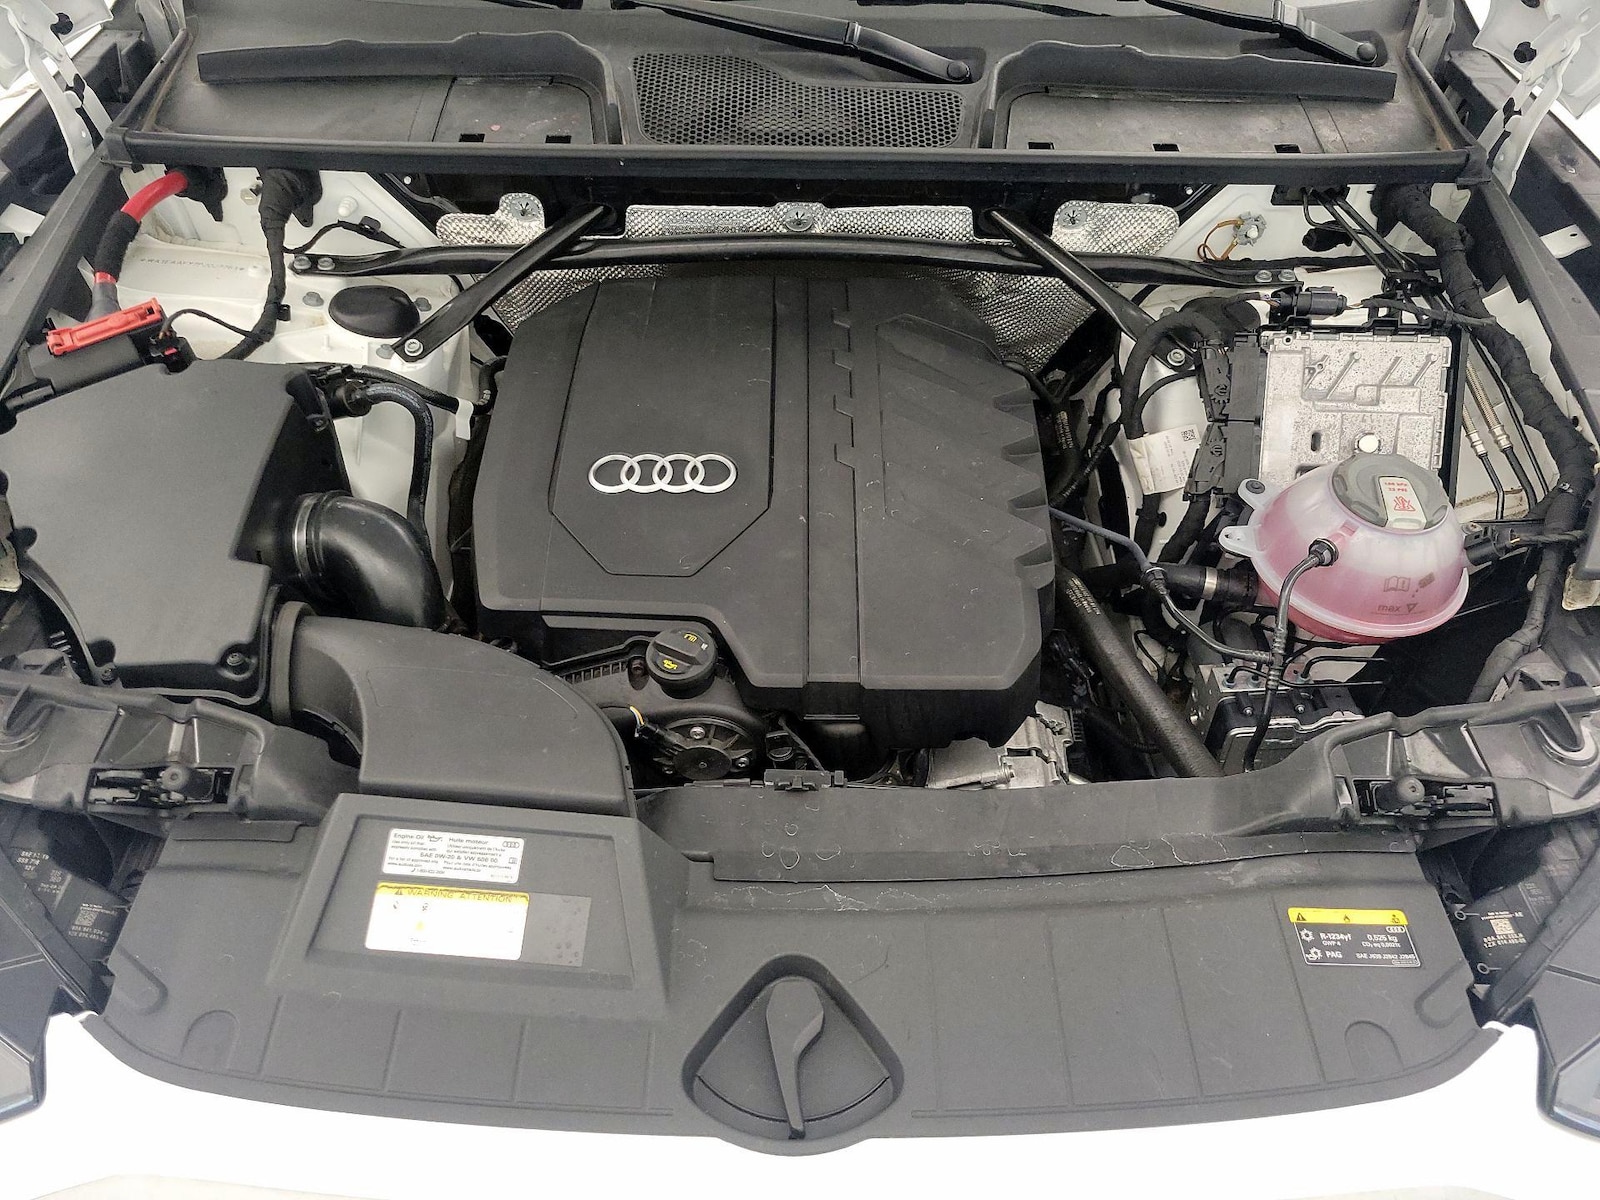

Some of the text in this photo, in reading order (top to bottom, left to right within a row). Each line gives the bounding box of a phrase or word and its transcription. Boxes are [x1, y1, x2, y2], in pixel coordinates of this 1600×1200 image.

[1377, 604, 1402, 613] max
[393, 832, 414, 840] Engine
[406, 887, 513, 903] WARNING ATTENTION
[1319, 932, 1399, 943] R-1234yf 0,525 kg
[1324, 950, 1343, 959] PAG
